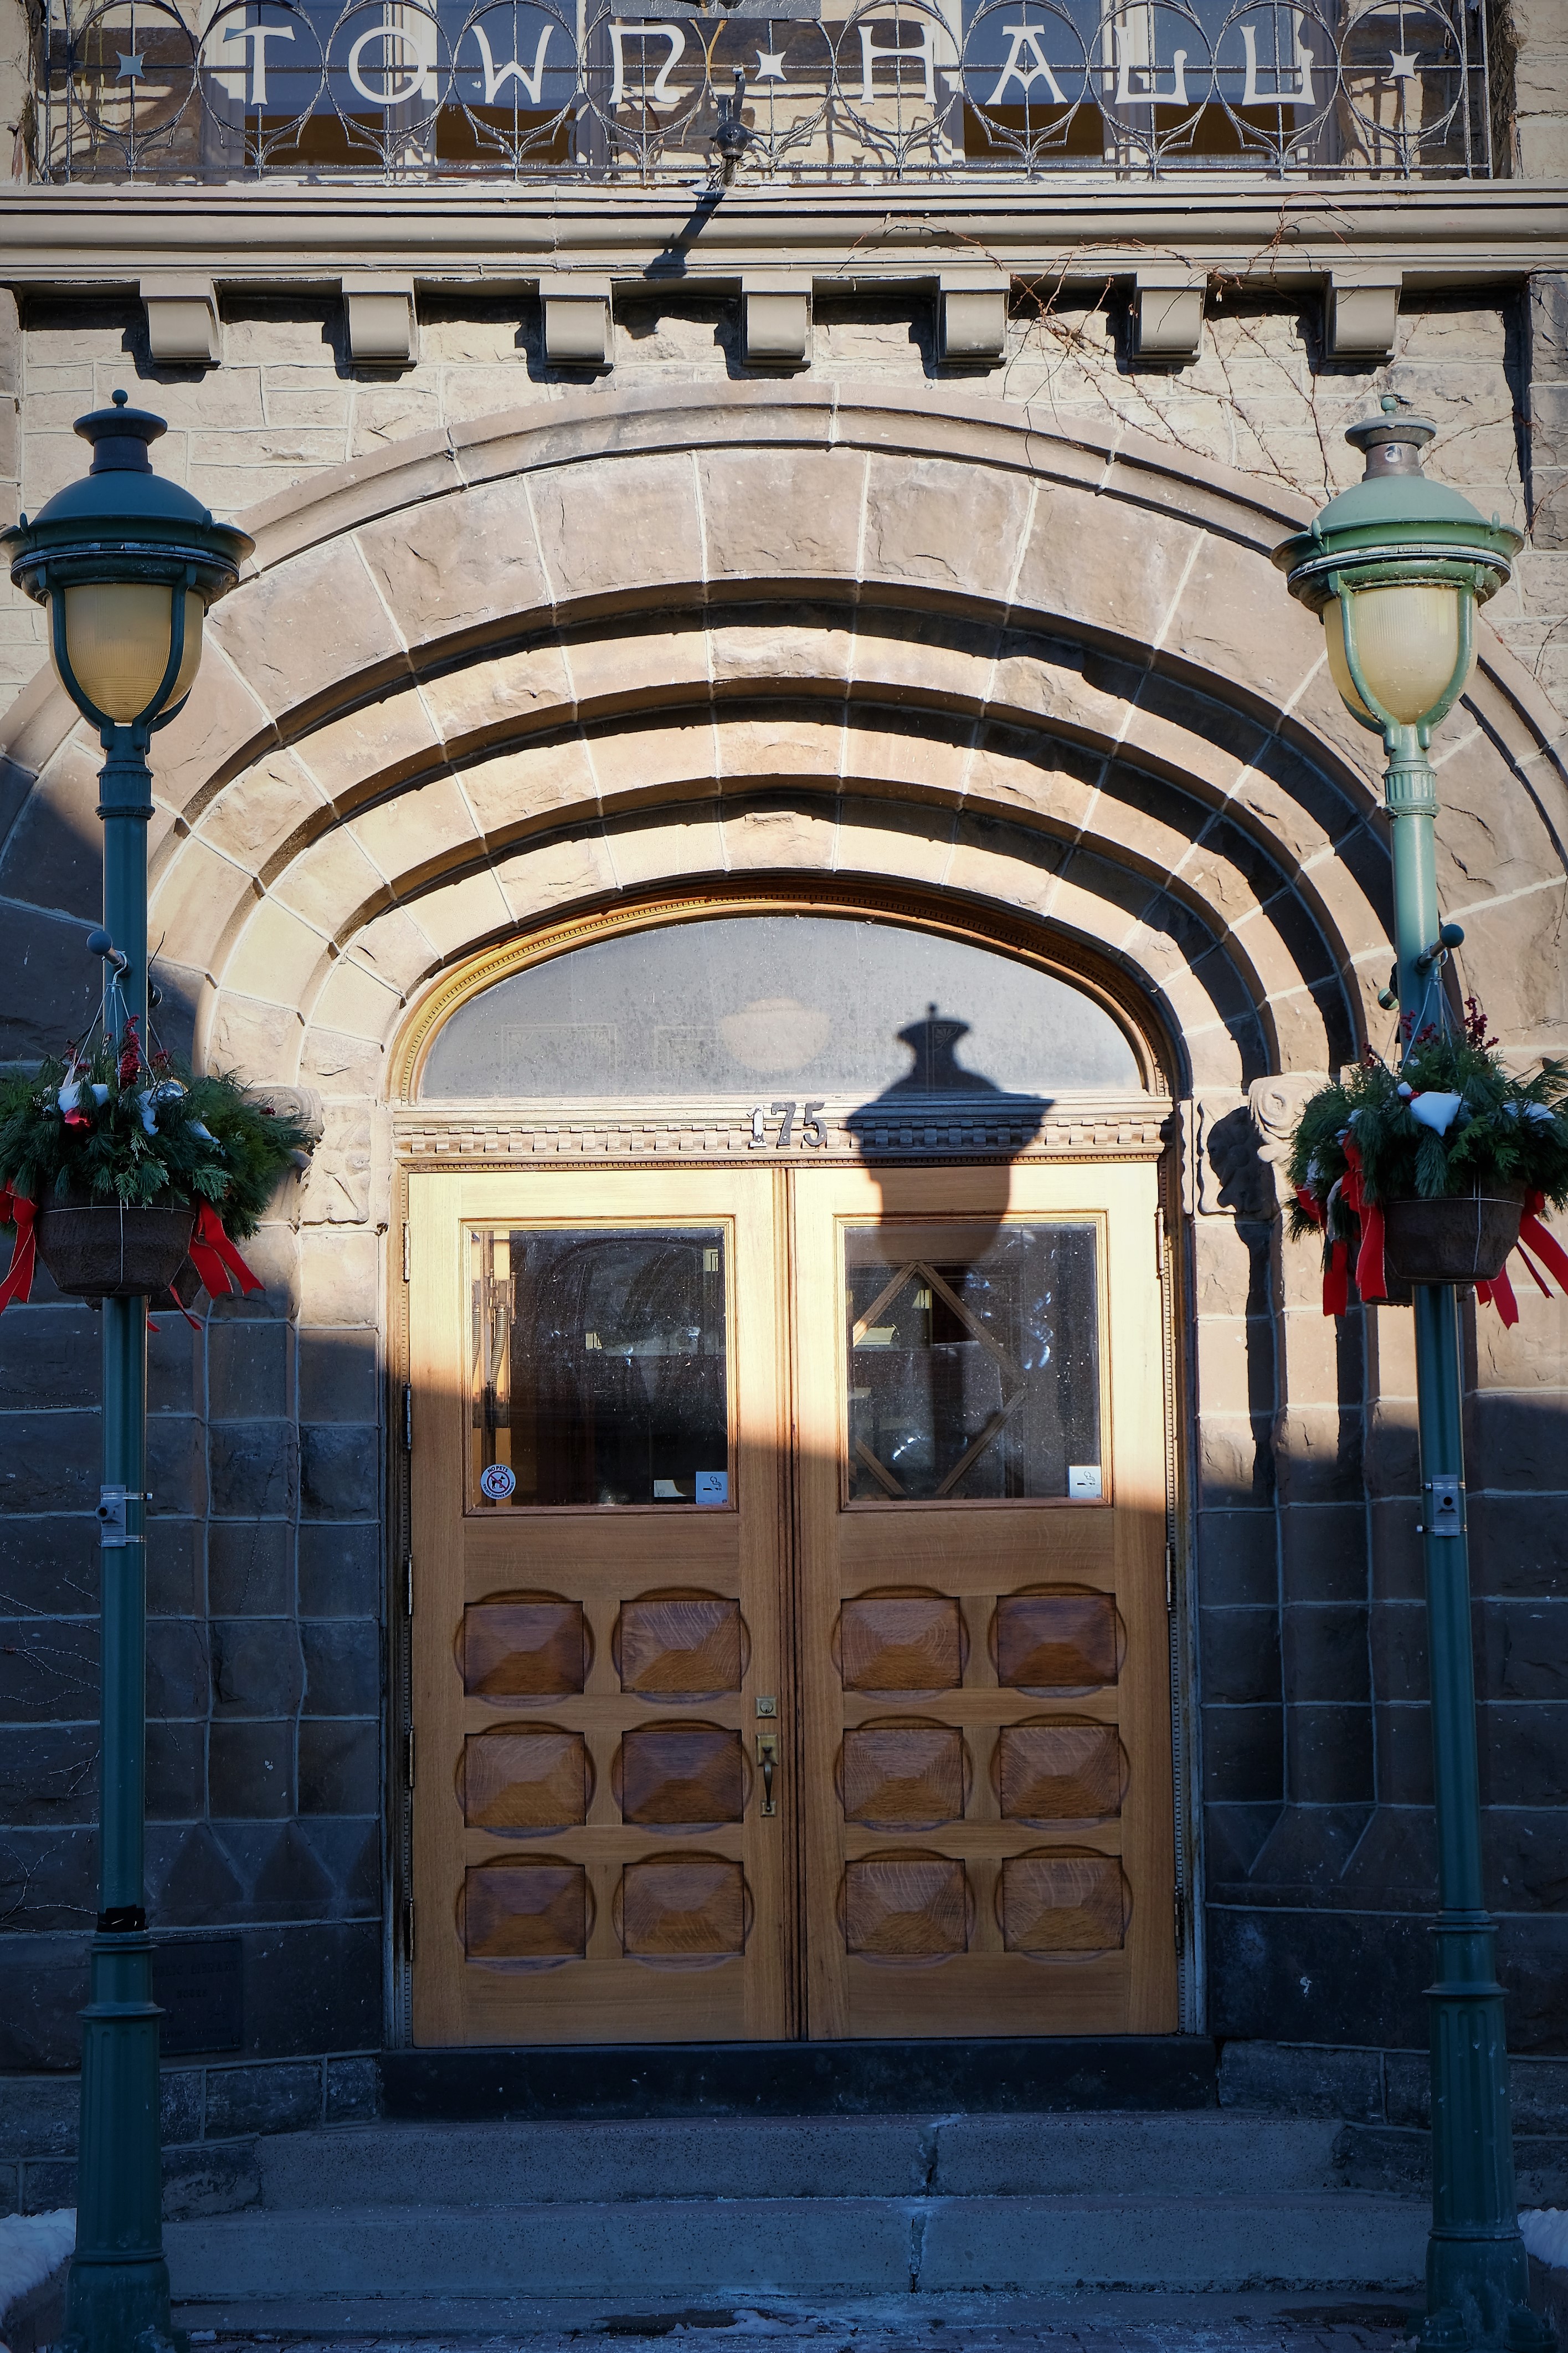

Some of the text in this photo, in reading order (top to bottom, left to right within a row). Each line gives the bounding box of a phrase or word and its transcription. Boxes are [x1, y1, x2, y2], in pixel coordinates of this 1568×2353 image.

[224, 24, 1317, 105] TOWN HALL
[747, 1102, 827, 1147] 175
